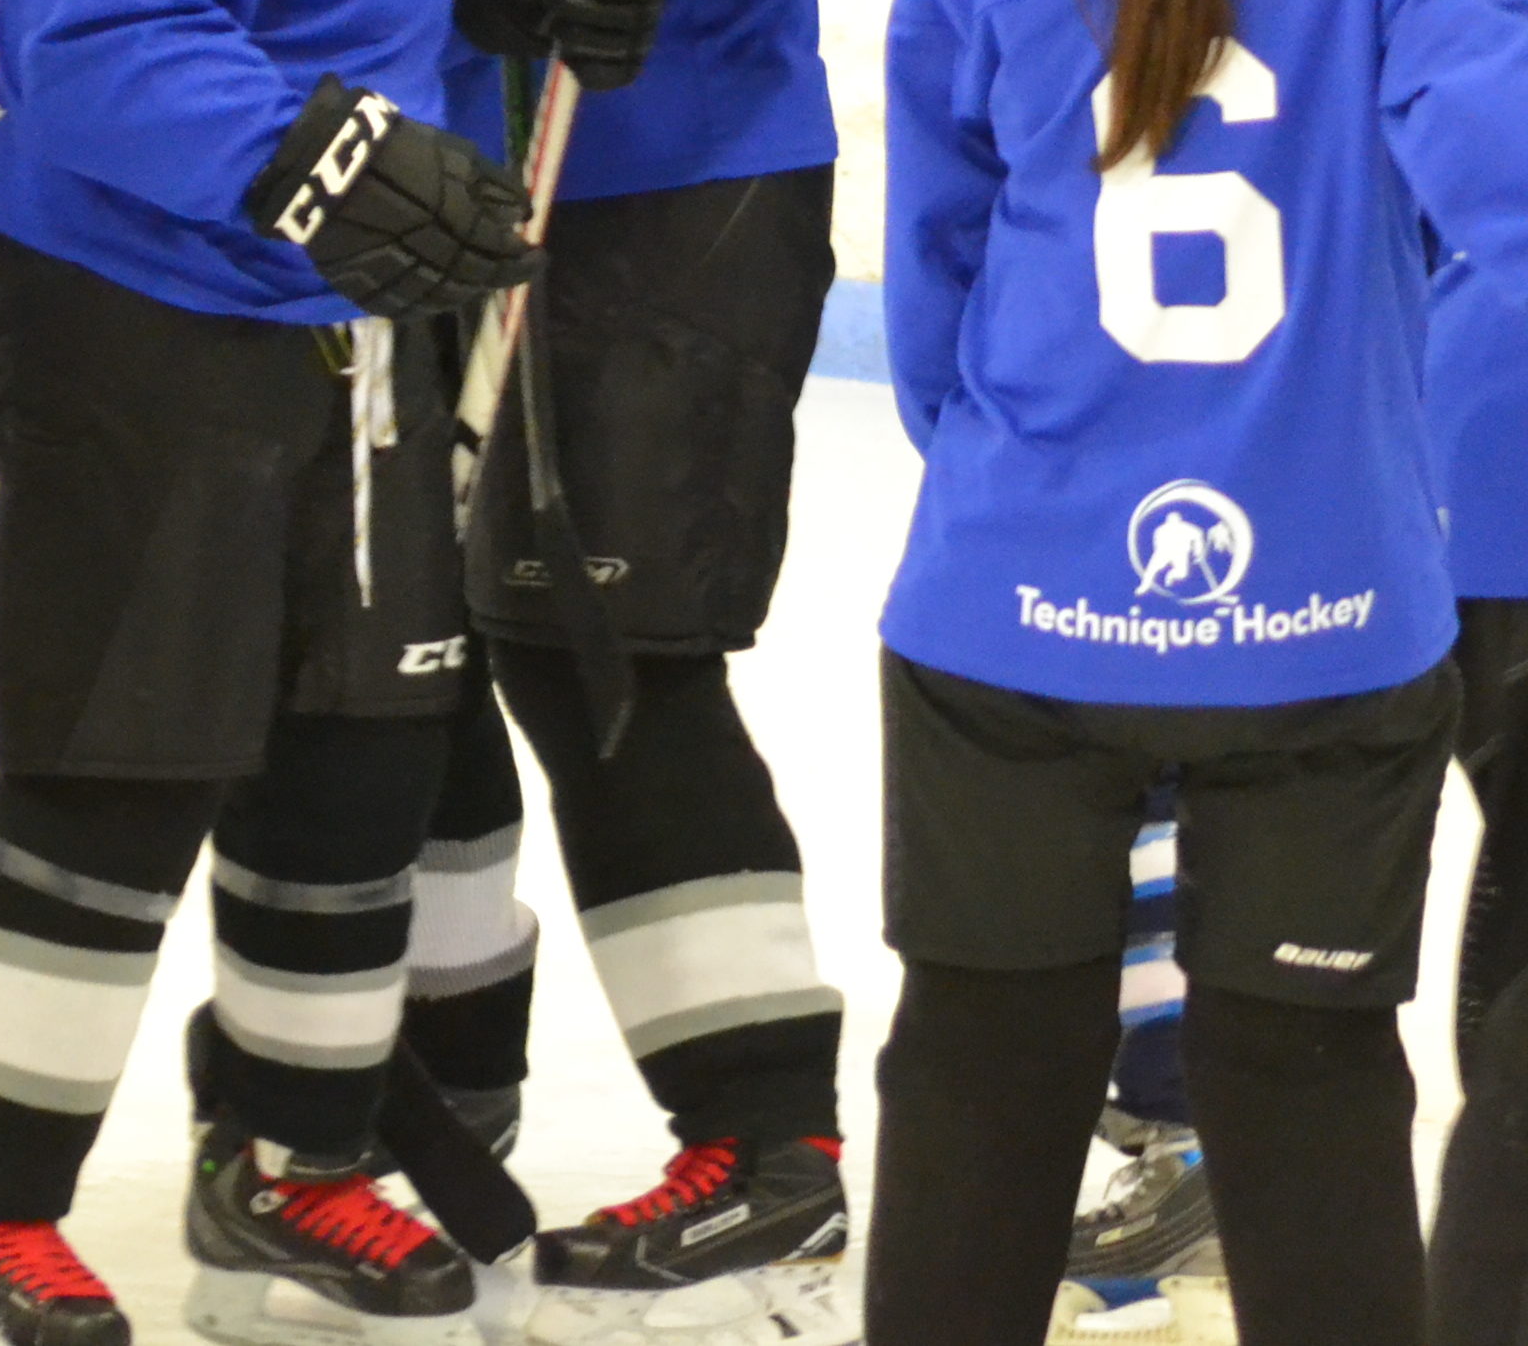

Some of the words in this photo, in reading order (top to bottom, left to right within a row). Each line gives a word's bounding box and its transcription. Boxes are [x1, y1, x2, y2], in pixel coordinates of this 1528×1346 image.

[274, 92, 401, 246] CCM
[1094, 36, 1286, 364] 6
[1016, 584, 1220, 655] Technique
[1231, 589, 1376, 644] Hockey
[1273, 942, 1374, 972] BAUER
